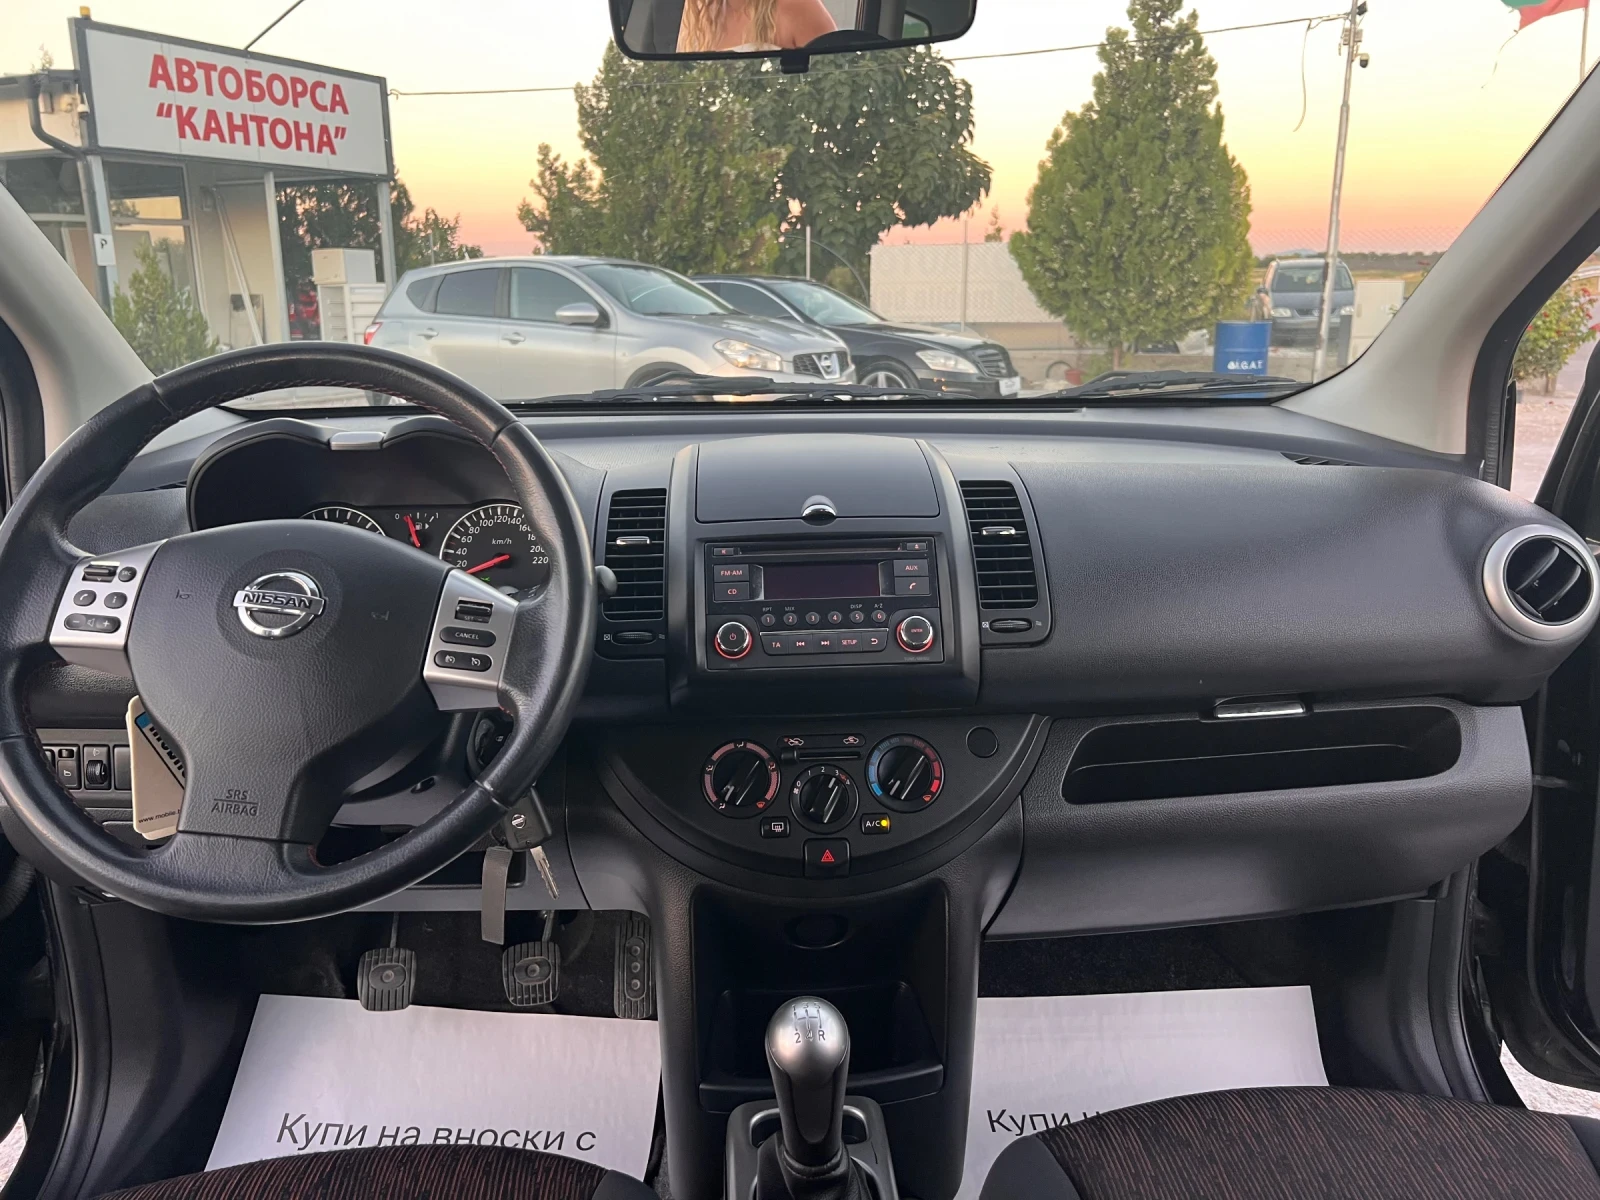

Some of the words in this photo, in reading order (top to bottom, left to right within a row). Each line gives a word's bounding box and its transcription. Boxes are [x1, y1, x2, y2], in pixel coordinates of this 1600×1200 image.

[148, 54, 350, 115] АВТОБОРСА
[479, 519, 494, 527] 100
[494, 515, 508, 523] 120
[507, 517, 522, 525] 140
[468, 526, 480, 534] 80
[461, 535, 473, 543] 60
[491, 537, 512, 545] km/h
[455, 547, 468, 555] 40
[456, 560, 468, 568] 20
[532, 556, 549, 564] 220
[242, 592, 313, 609] NISSAN
[455, 632, 479, 640] CANCEL
[226, 789, 249, 800] SRS
[211, 802, 258, 816] AIRBAG
[794, 1032, 801, 1043] 2
[805, 1030, 813, 1041] 4
[818, 1029, 826, 1041] R
[987, 1109, 1071, 1136] Купи
[276, 1112, 368, 1151] Купи
[376, 1126, 421, 1147] на
[432, 1127, 566, 1151] вноски
[575, 1131, 597, 1152] с
